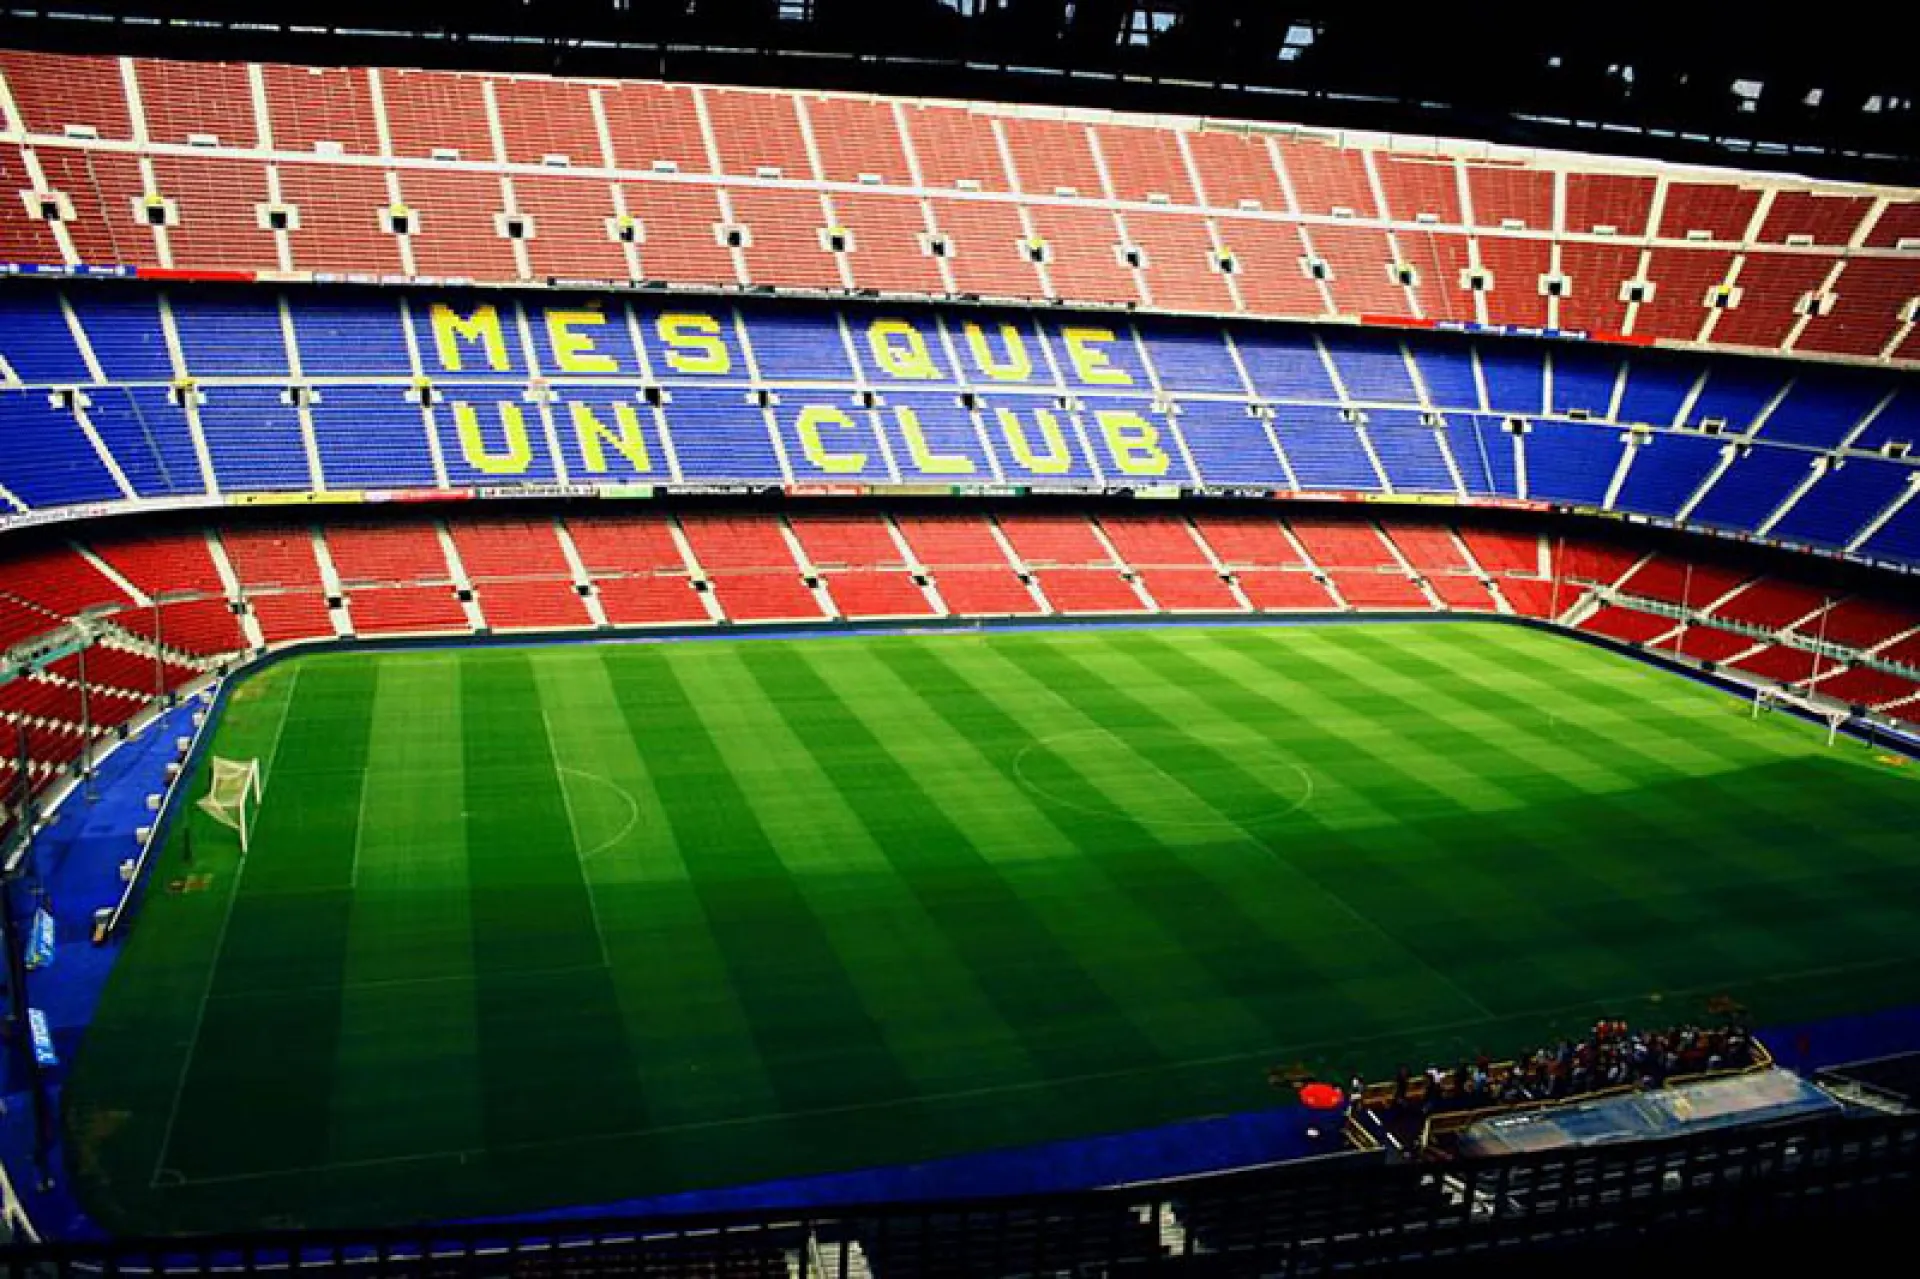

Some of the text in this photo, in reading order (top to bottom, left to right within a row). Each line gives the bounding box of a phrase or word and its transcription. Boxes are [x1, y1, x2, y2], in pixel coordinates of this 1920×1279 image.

[866, 318, 1134, 385] QUE
[451, 400, 1170, 476] UN CLUB
